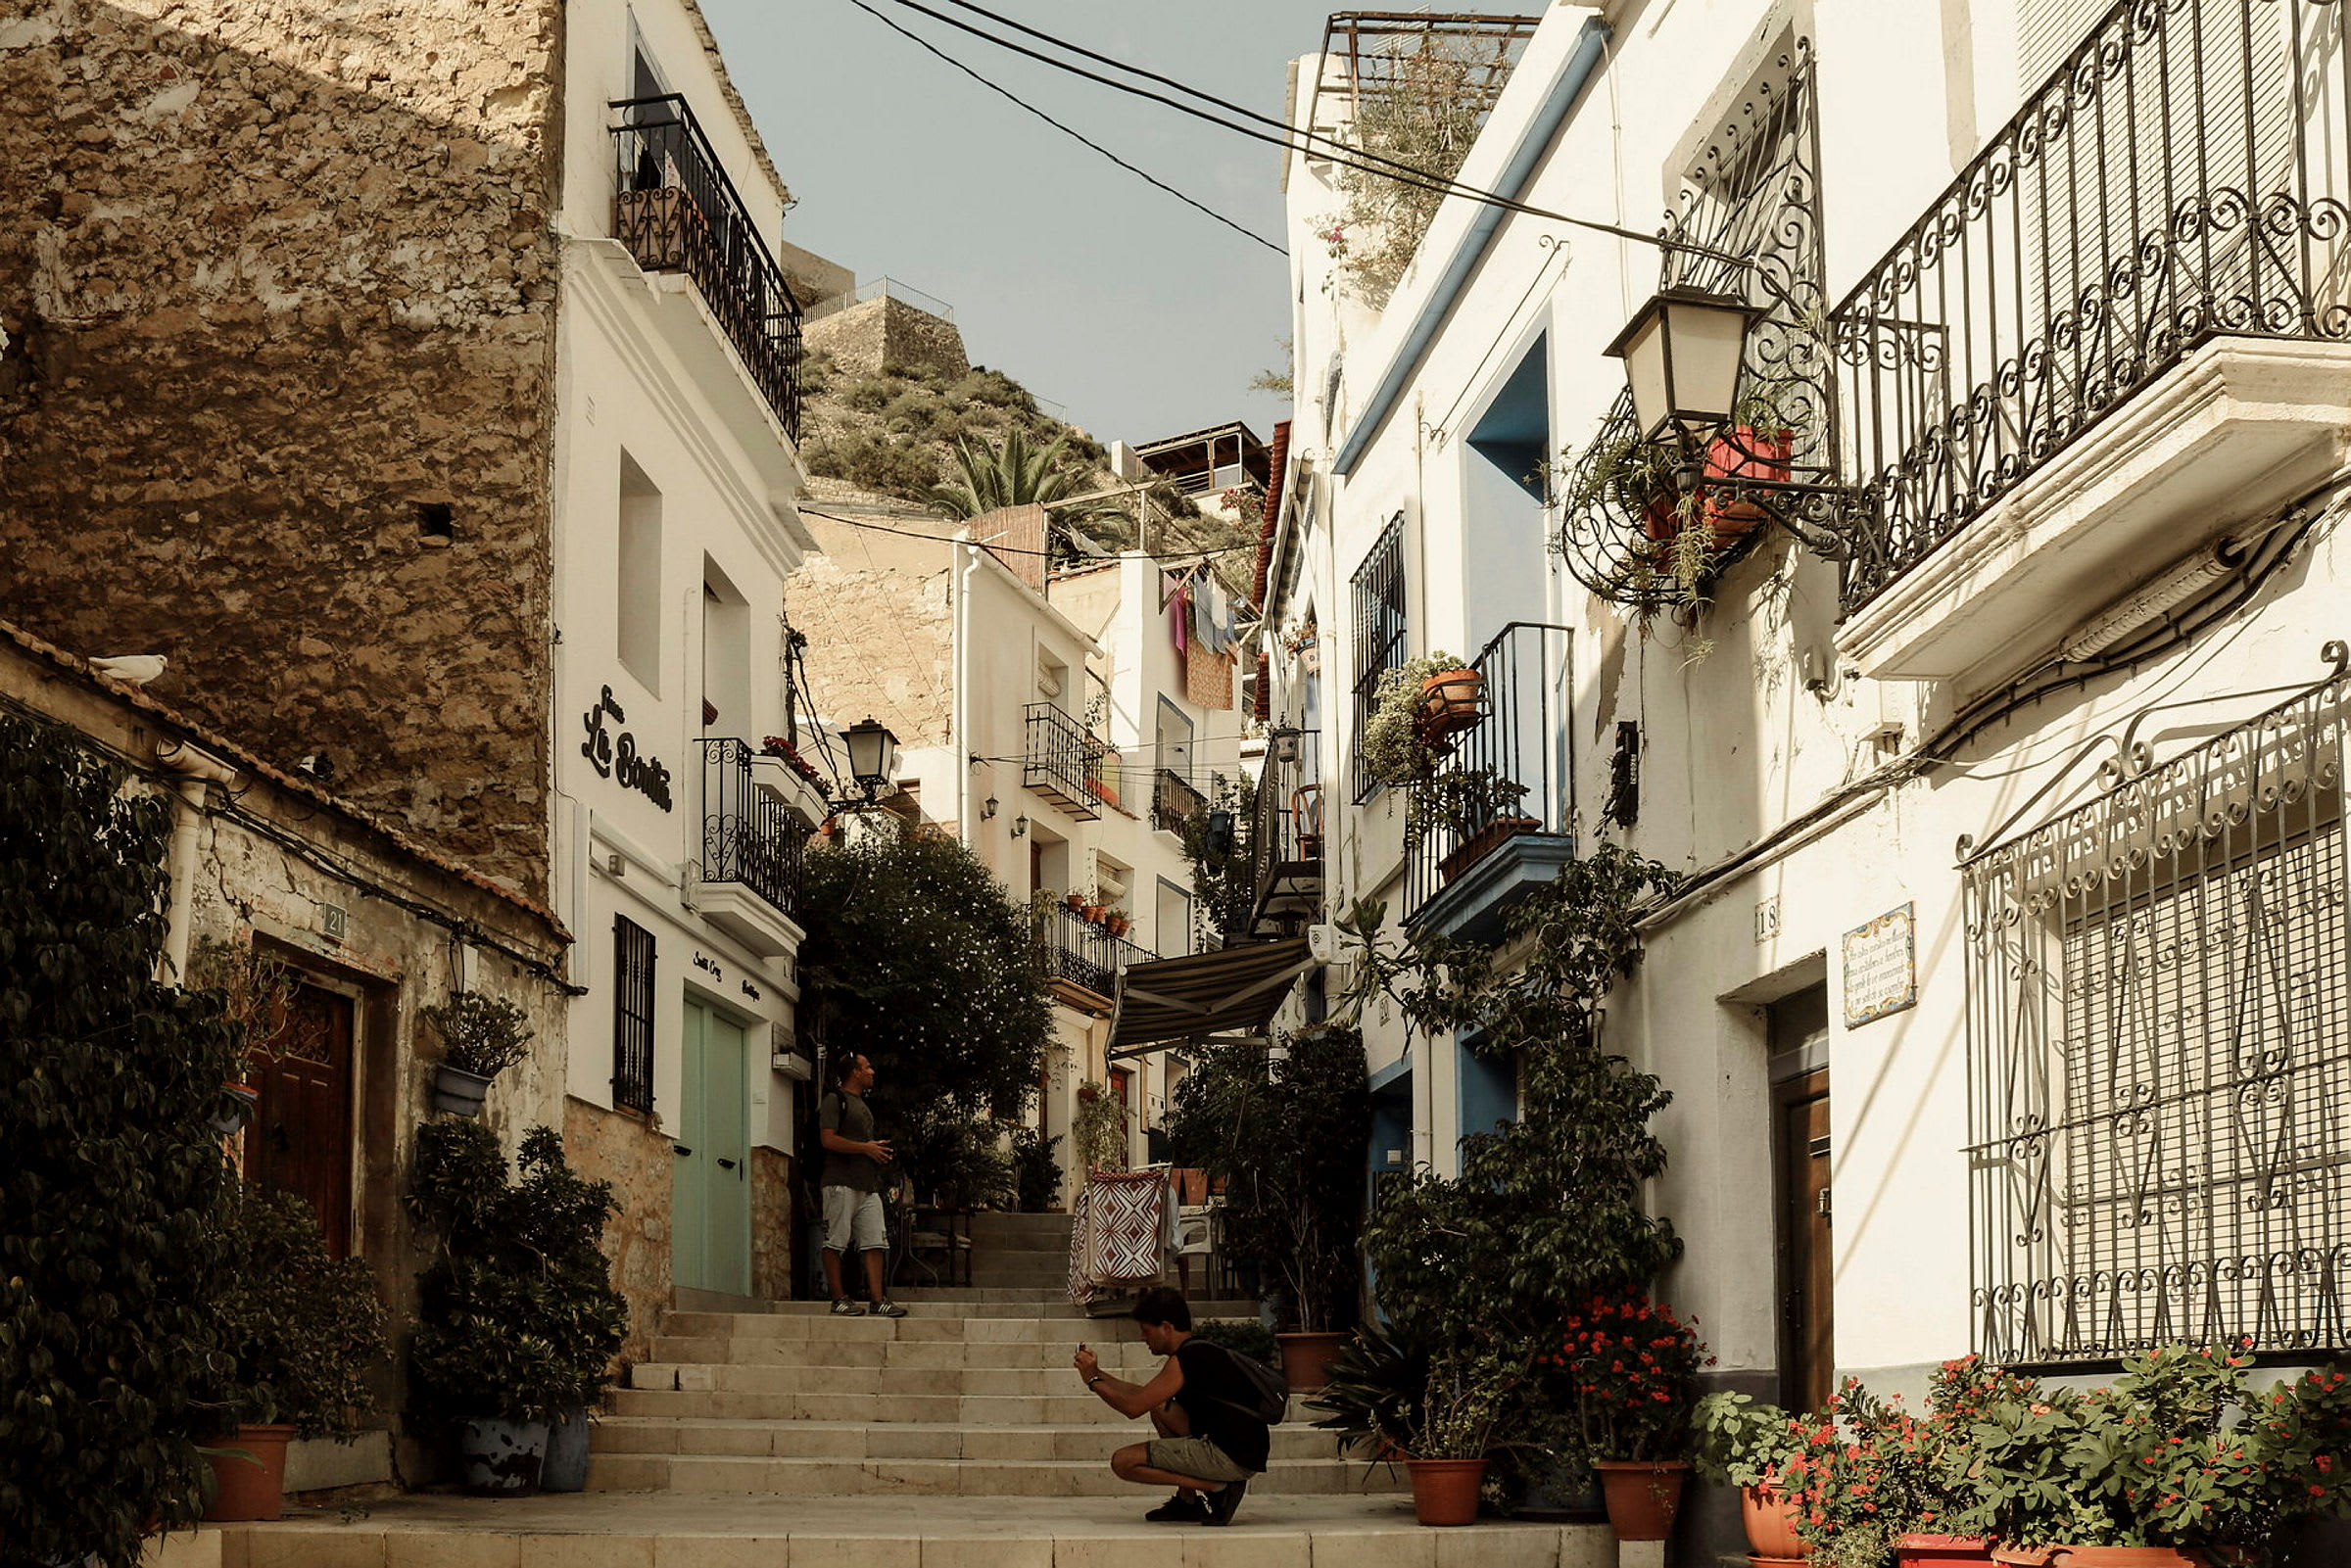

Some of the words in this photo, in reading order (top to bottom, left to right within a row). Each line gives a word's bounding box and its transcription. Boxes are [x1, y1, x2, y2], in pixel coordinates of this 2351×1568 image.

[581, 703, 612, 779] La
[329, 911, 343, 931] 21
[1760, 905, 1776, 934] 18
